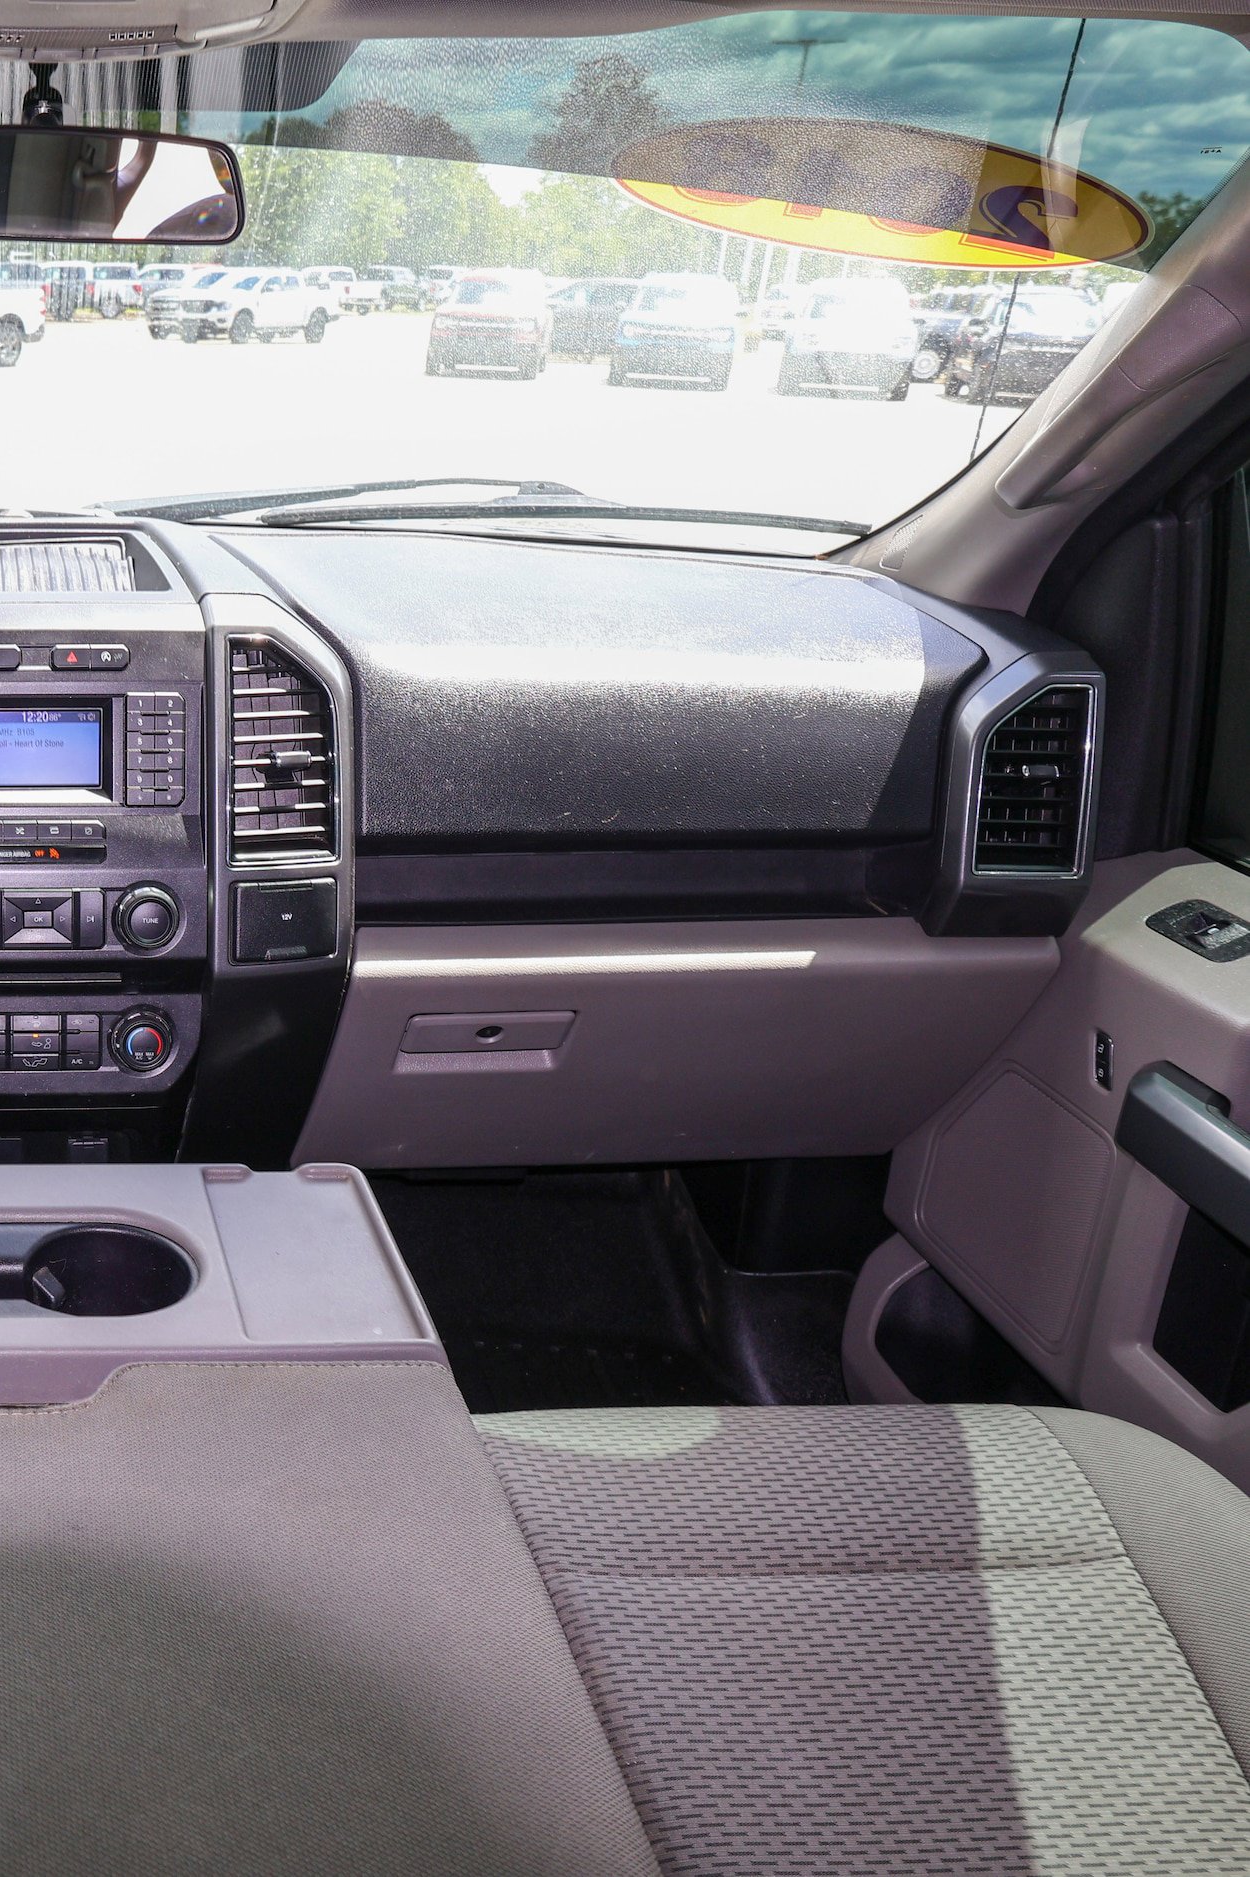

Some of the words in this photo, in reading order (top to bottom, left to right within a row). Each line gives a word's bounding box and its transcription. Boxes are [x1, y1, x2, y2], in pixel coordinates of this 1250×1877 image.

[22, 710, 49, 722] 12:20
[138, 718, 143, 726] 3
[138, 737, 143, 745] 5
[168, 737, 173, 745] 6
[137, 775, 142, 783] 9
